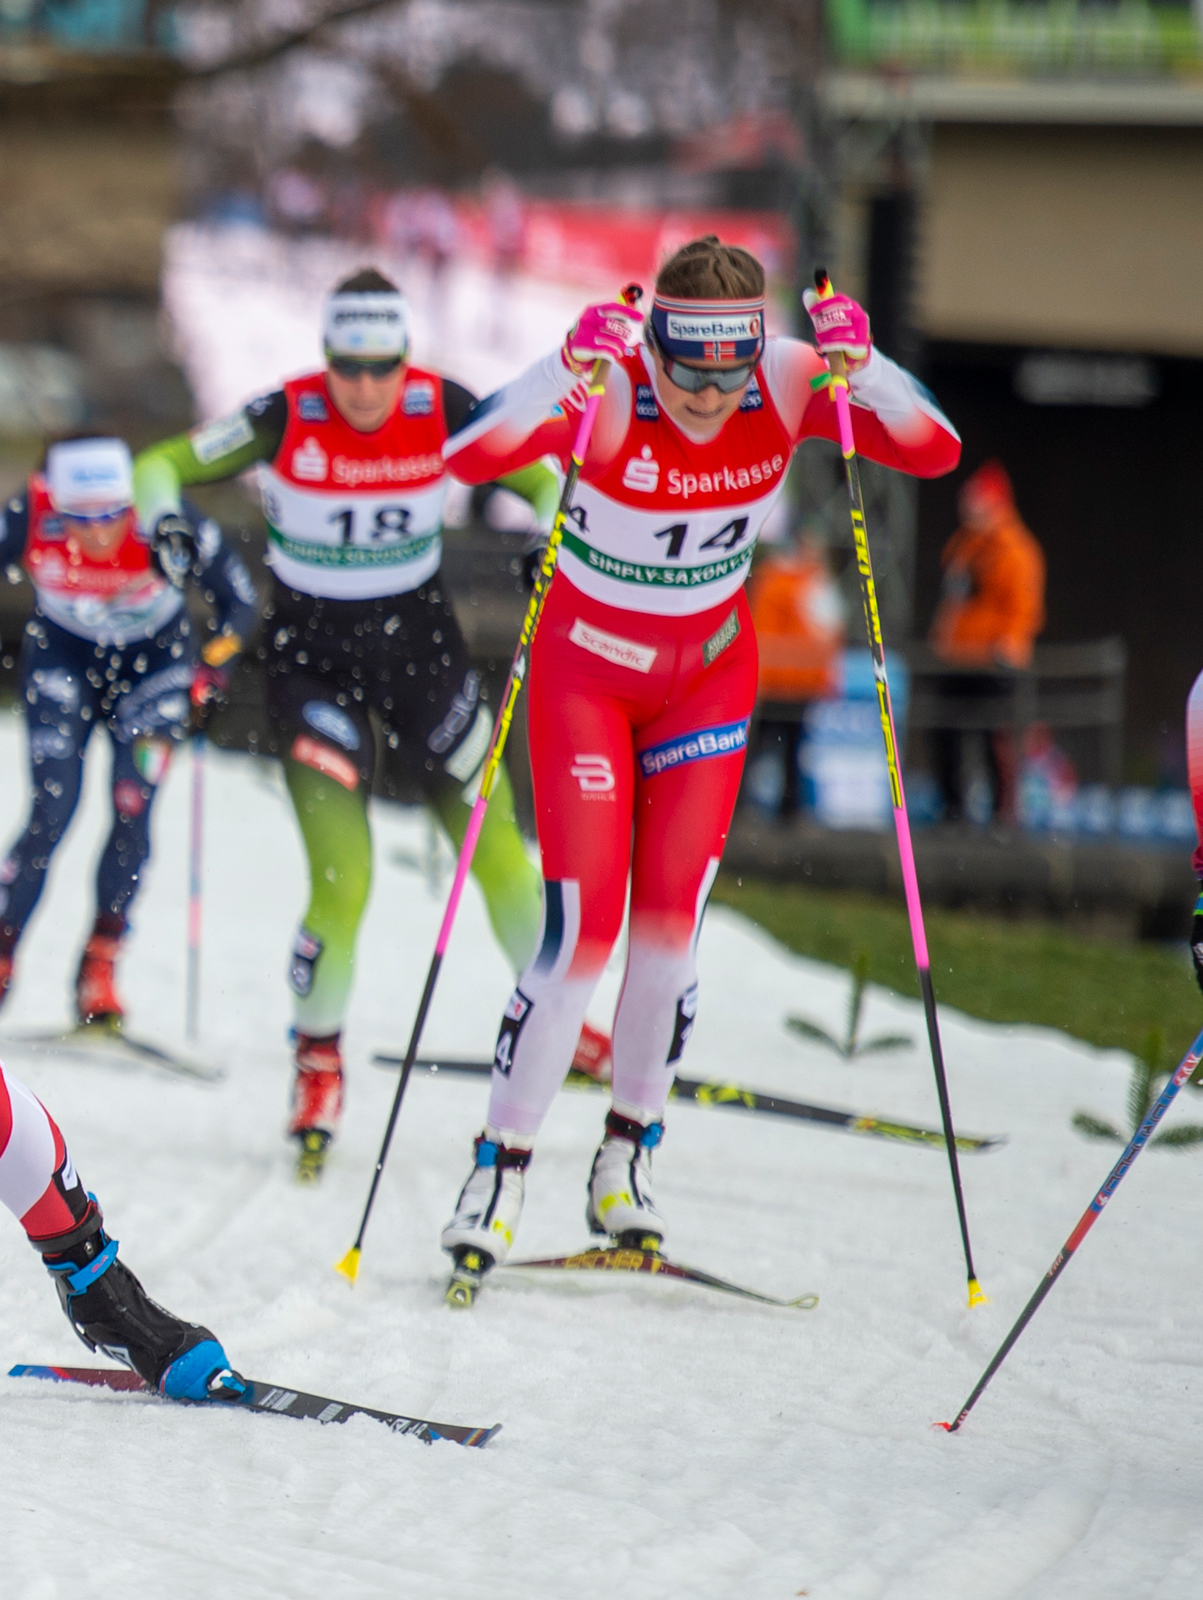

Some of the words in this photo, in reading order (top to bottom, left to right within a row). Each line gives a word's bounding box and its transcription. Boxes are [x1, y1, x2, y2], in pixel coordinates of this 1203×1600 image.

[669, 322, 748, 338] SpareBank
[667, 454, 784, 499] Sparkasse
[329, 504, 412, 547] 18
[654, 516, 750, 560] 14
[850, 509, 871, 576] LEKI
[580, 630, 646, 666] Scandic
[641, 728, 747, 774] SpareBank
